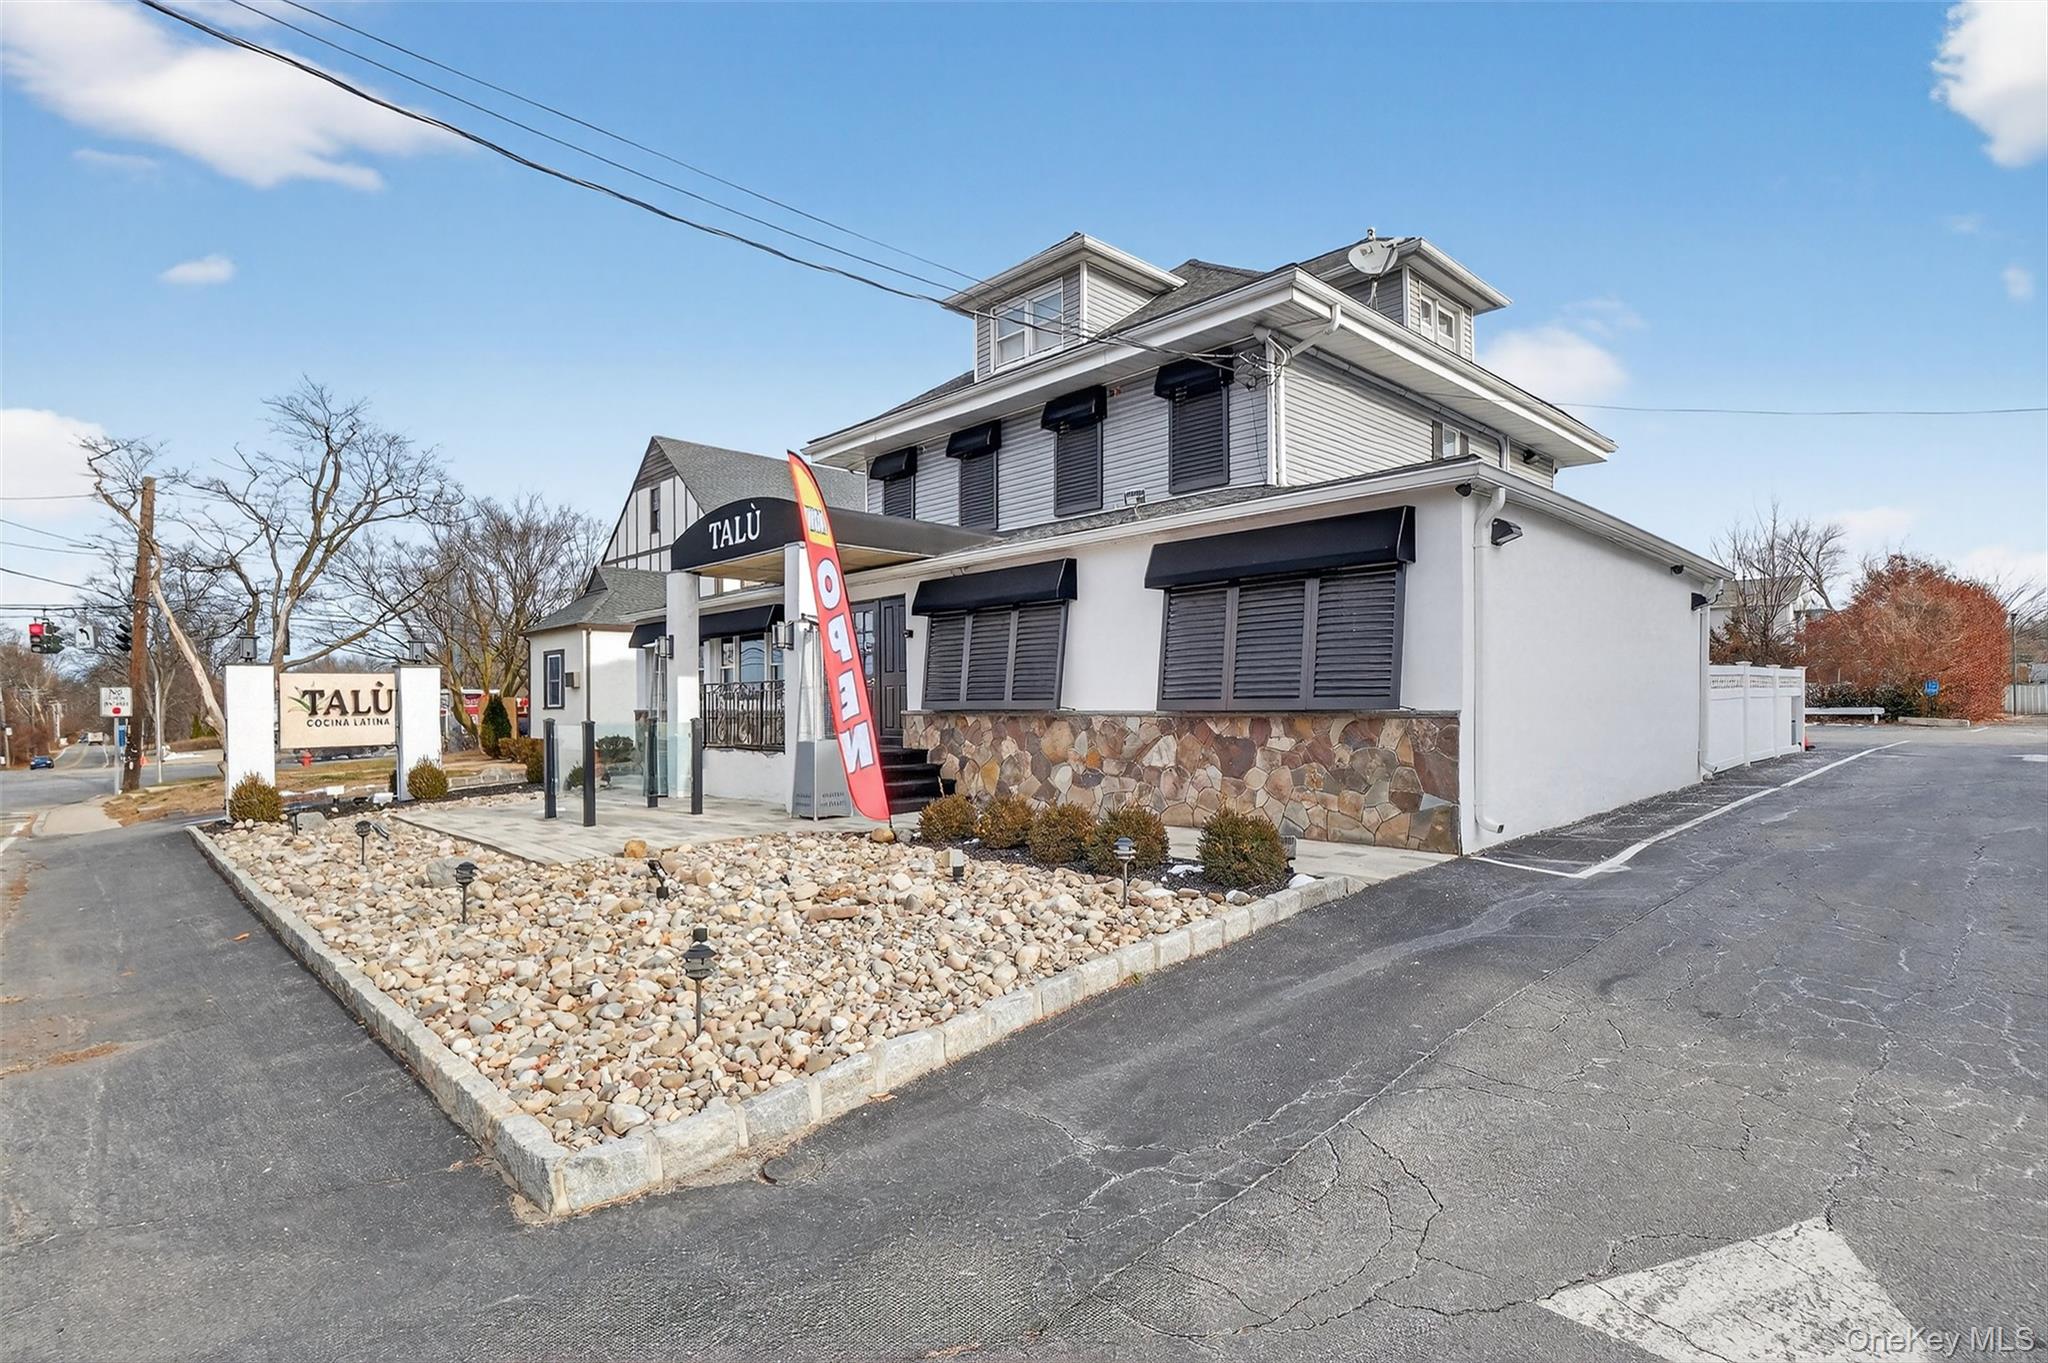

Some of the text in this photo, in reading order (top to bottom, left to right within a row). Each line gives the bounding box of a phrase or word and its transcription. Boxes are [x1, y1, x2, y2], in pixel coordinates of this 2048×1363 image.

[708, 502, 762, 550] TALÙ
[301, 681, 395, 716] TALÙ
[306, 718, 390, 728] COCINA LATINA
